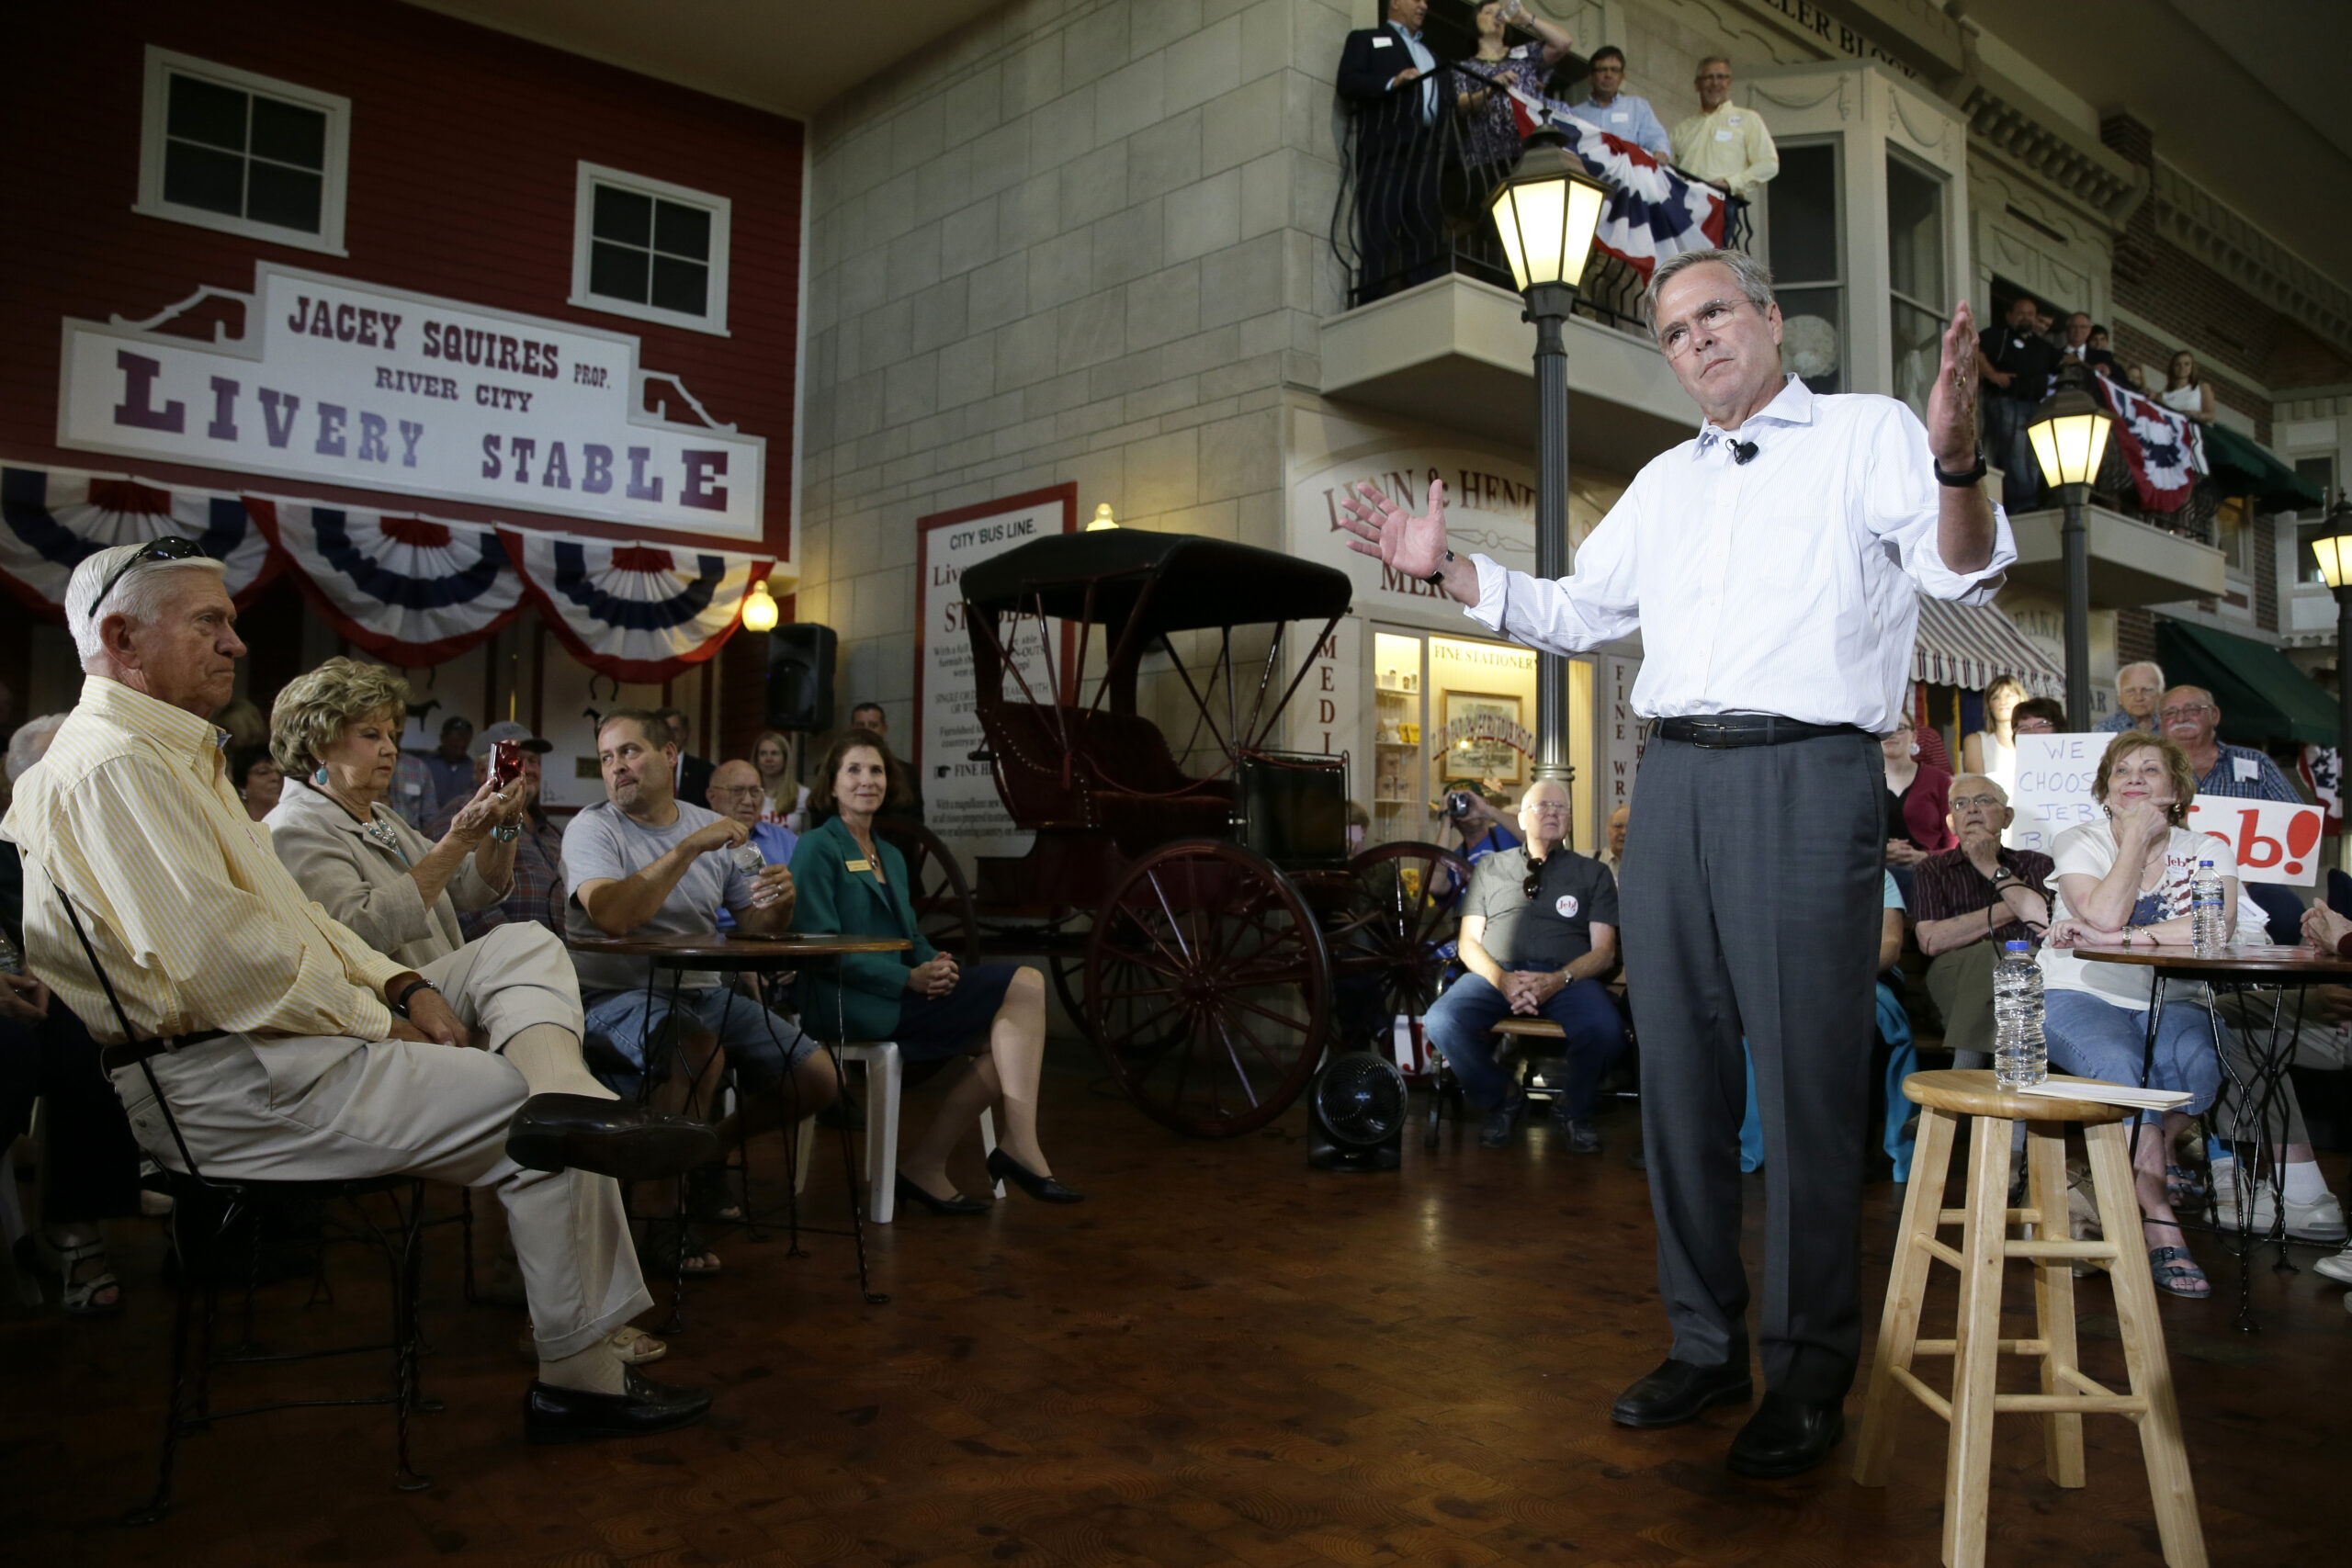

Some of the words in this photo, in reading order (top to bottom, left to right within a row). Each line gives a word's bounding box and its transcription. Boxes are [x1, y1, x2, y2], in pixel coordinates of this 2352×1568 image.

[288, 295, 403, 351] JACEY
[423, 319, 560, 379] SQUIRES
[573, 363, 611, 390] PROP.
[375, 367, 459, 401] RIVER
[475, 383, 535, 414] CITY
[114, 348, 424, 469] LIVERY
[482, 434, 729, 512] STABLE
[950, 531, 975, 550] CITY
[1434, 645, 1463, 660] FINE
[2043, 739, 2084, 759] WE
[2019, 772, 2096, 793] CHOOS
[2033, 803, 2095, 822] JEB
[2186, 805, 2321, 875] b!
